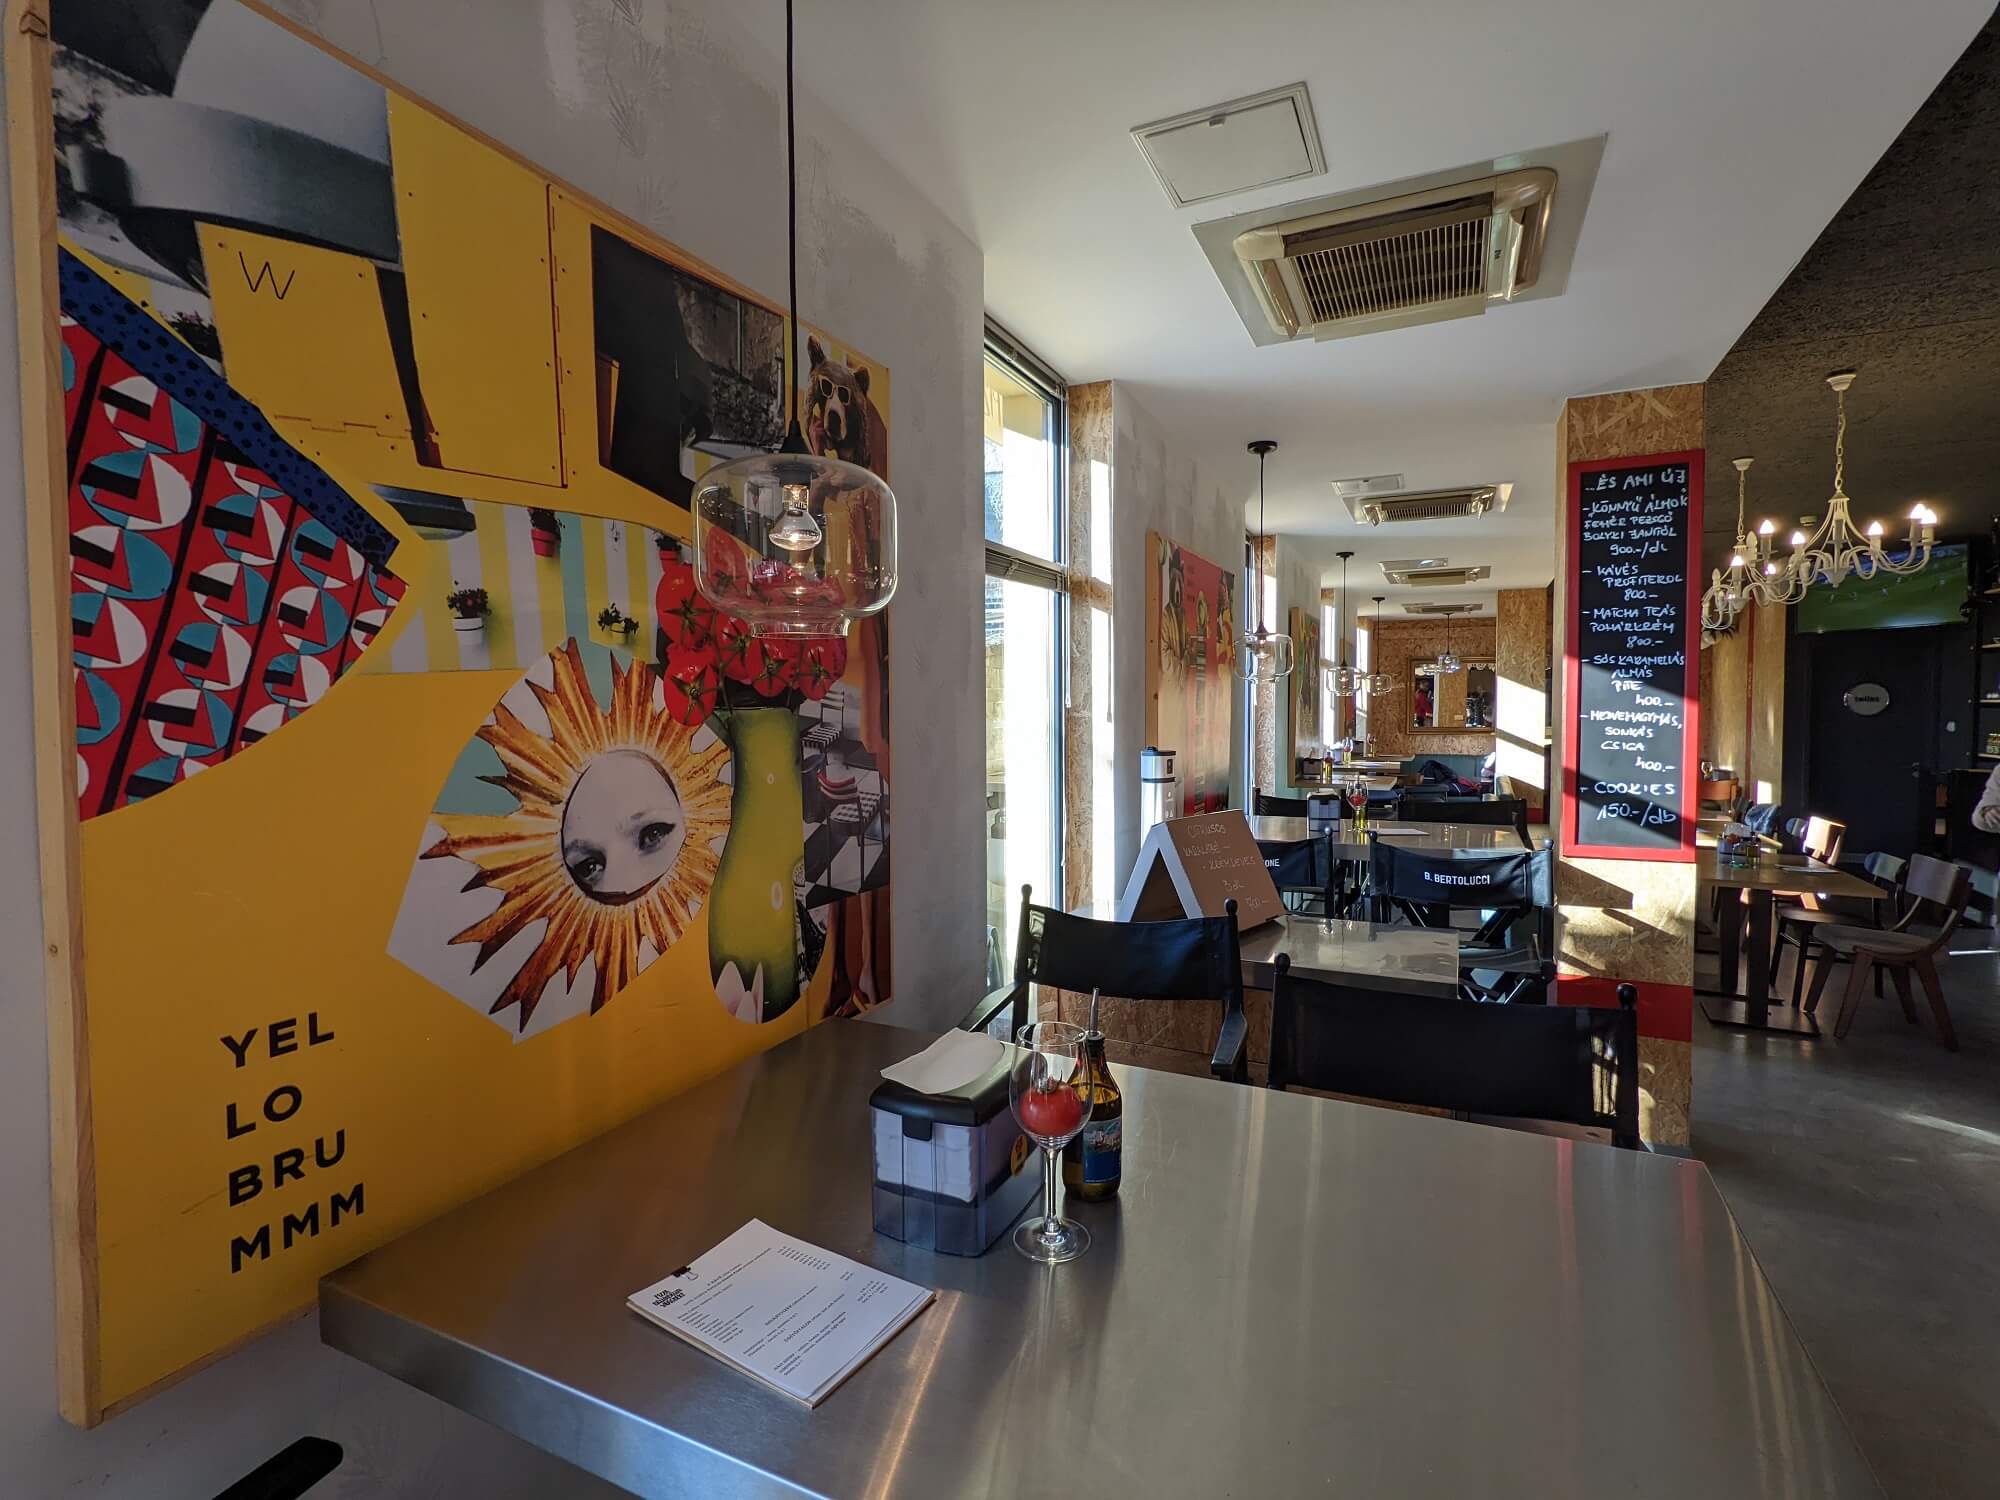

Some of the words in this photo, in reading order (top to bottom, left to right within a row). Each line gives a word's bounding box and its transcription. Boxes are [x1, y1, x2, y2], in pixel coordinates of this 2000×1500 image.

[1623, 474, 1653, 490] AMI
[1661, 468, 1686, 484] ÚJ
[1584, 516, 1627, 529] FEHÉR
[1597, 562, 1639, 576] KÁVÉS
[1602, 574, 1684, 588] PROFITEROL
[1593, 607, 1639, 619] MATCHA
[1643, 603, 1676, 617] TEÁS
[1589, 618, 1675, 634] POHÁRKRÉM
[1593, 653, 1616, 665] SÓS
[1611, 664, 1653, 679] ALMÁS
[1611, 680, 1643, 693] PITE
[1604, 725, 1654, 738] SONKÁS
[1600, 740, 1645, 752] CSIGA
[1594, 782, 1675, 796] COOKIES
[1434, 874, 1490, 885] BERTOLUCCI
[219, 1012, 335, 1068] YEL
[225, 1085, 303, 1140] LO
[228, 1128, 346, 1208] BRU
[231, 1182, 364, 1275] MMM
